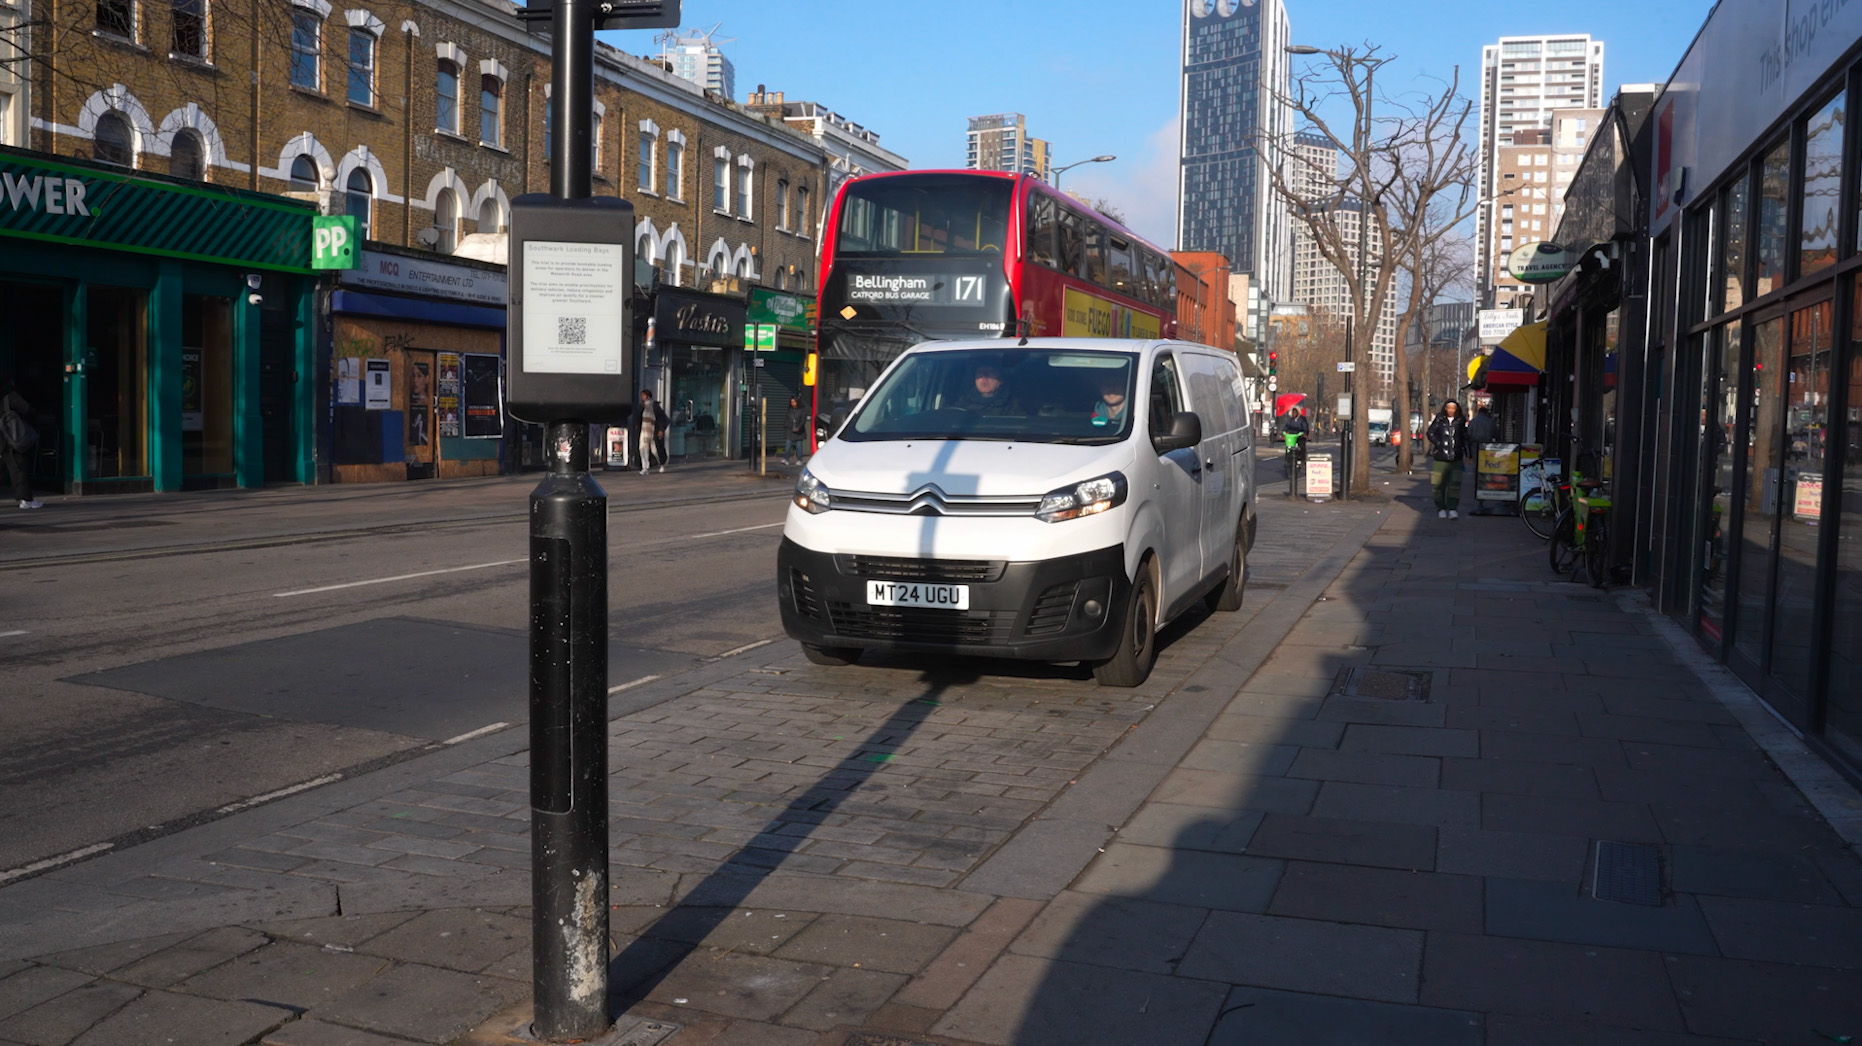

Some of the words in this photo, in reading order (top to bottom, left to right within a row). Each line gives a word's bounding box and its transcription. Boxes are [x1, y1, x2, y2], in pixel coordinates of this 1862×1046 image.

[1760, 40, 1780, 96] This
[1784, 3, 1818, 68] shop
[380, 260, 400, 277] MCQ
[408, 270, 461, 286] ENTERTAINMENT
[462, 278, 474, 288] LTD
[856, 276, 926, 292] Bellingham
[955, 276, 982, 300] 171
[1088, 307, 1111, 336] FUEGO
[876, 584, 920, 602] MT24
[925, 586, 960, 604] UGU
